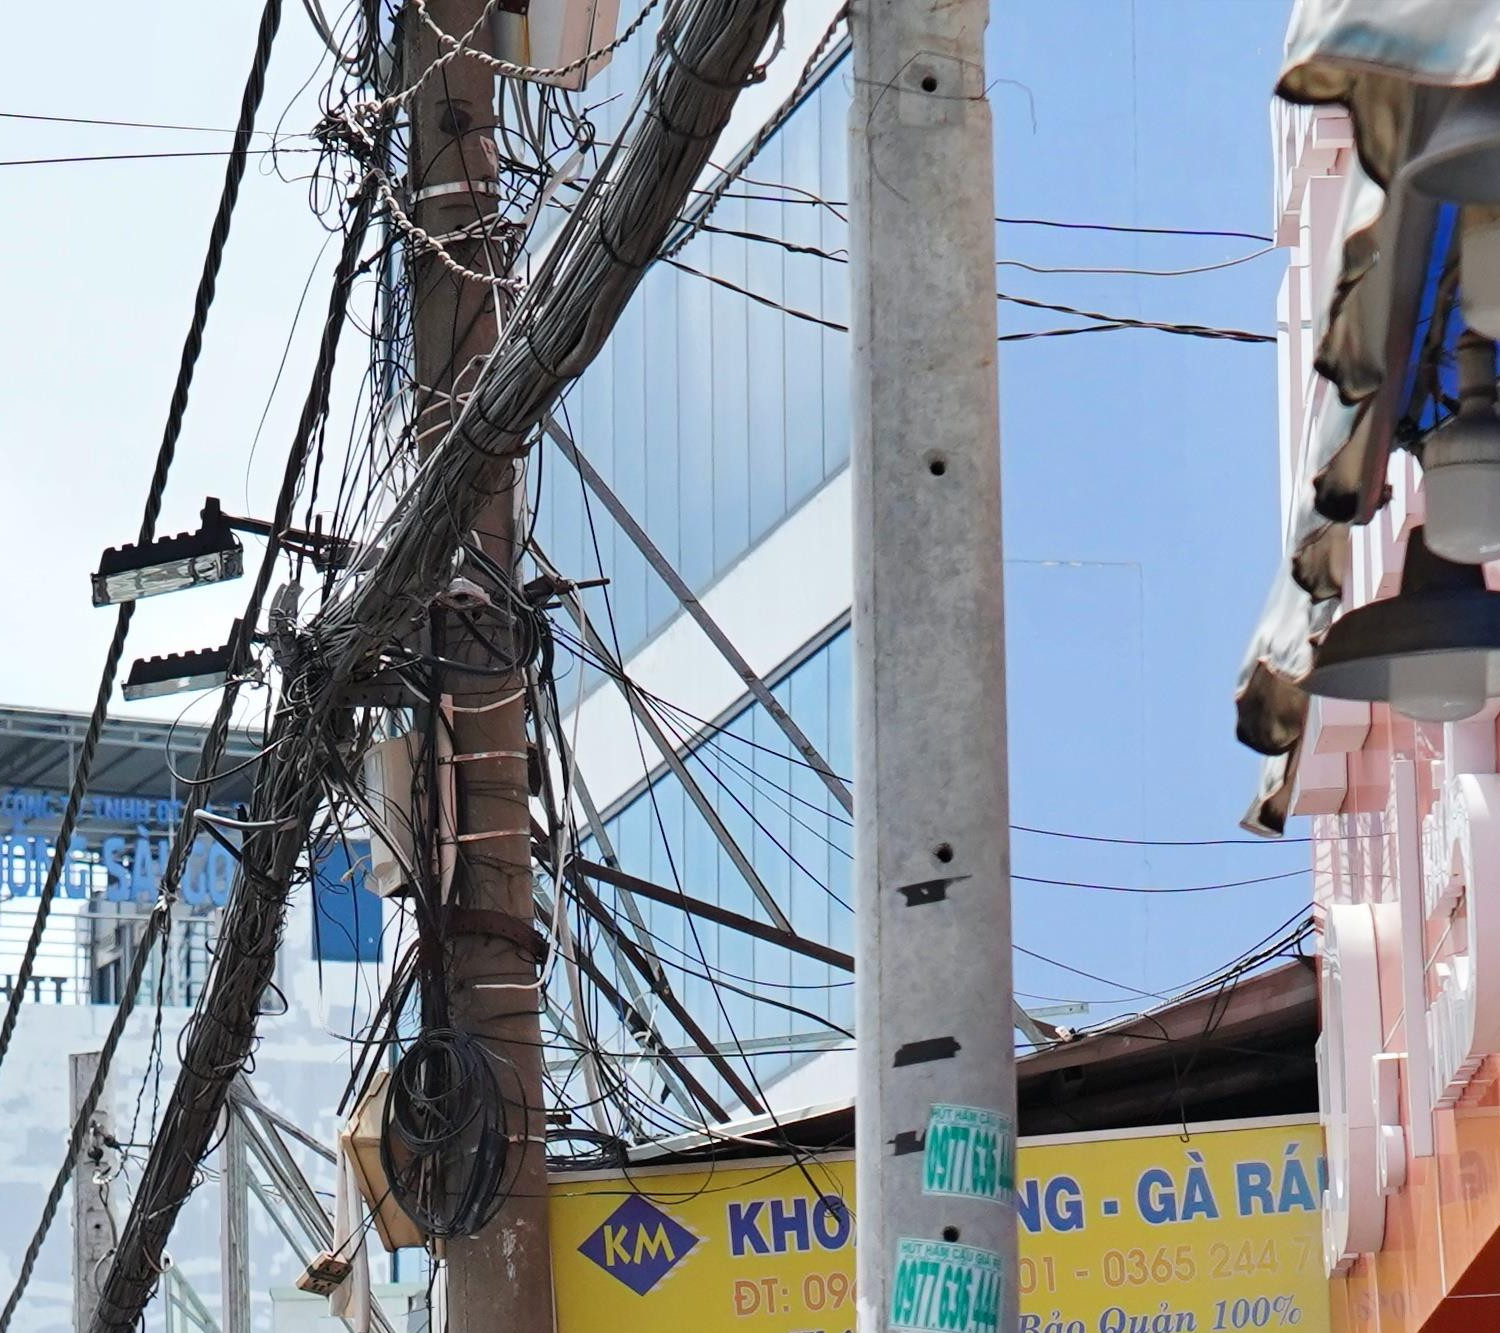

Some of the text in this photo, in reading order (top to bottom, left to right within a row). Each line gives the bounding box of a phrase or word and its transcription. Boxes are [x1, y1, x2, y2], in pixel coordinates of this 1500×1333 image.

[728, 1194, 857, 1257] KHO
[1137, 1150, 1221, 1224] GÀ
[1236, 1143, 1328, 1216] RÁ
[602, 1221, 677, 1268] KM
[733, 1276, 790, 1318] ĐT:
[1103, 1243, 1197, 1289] 0365
[1209, 1237, 1279, 1282] 244
[1212, 1292, 1303, 1331] 100%
